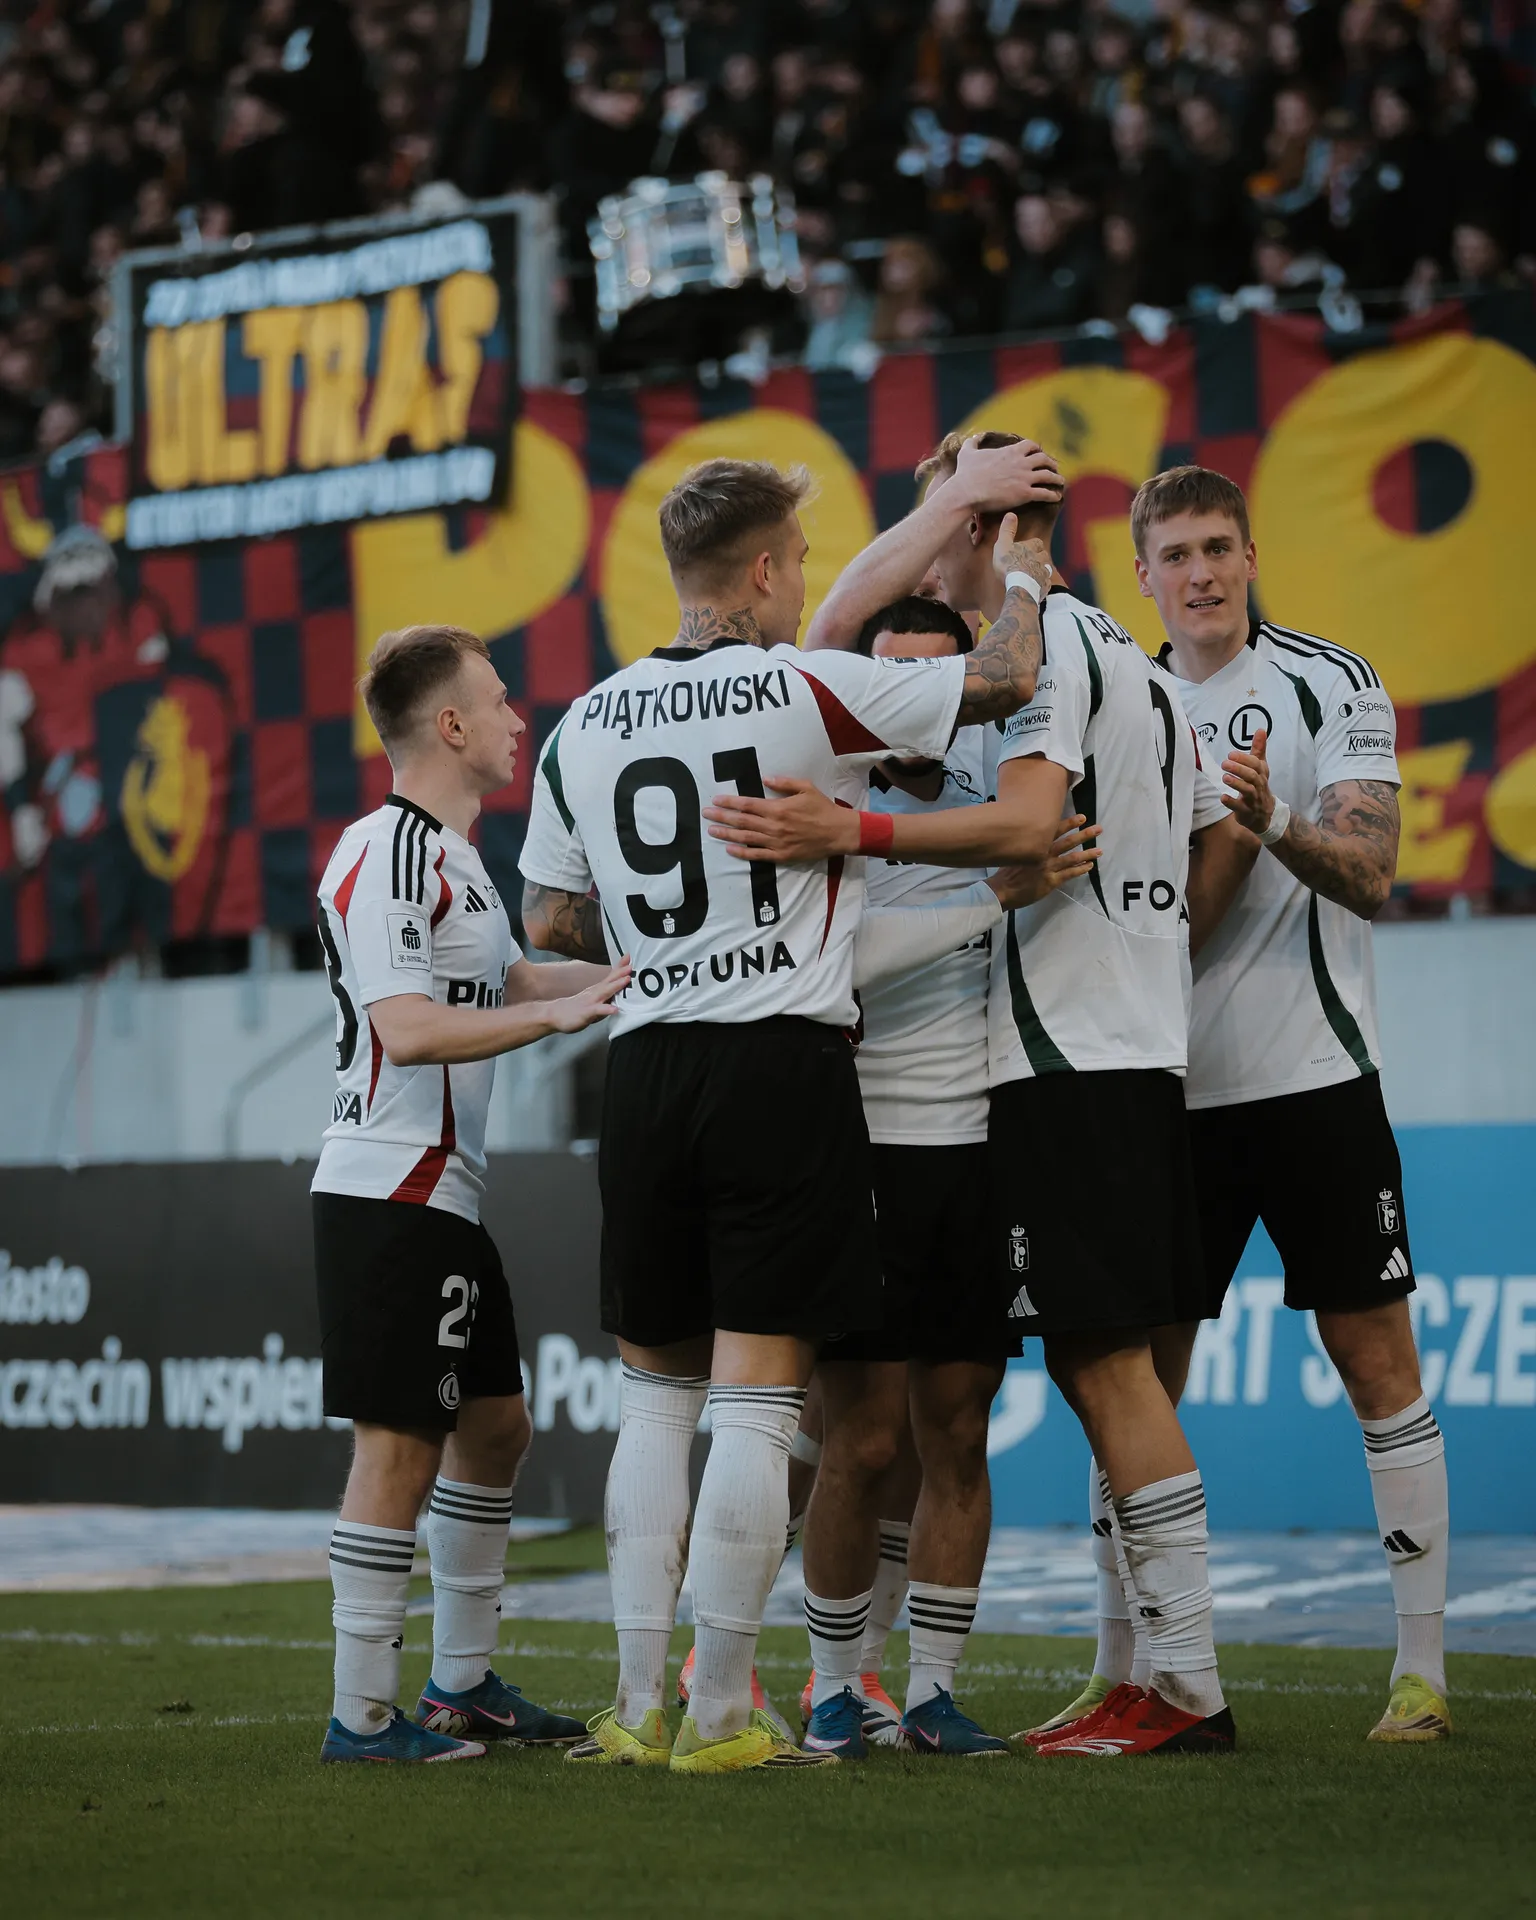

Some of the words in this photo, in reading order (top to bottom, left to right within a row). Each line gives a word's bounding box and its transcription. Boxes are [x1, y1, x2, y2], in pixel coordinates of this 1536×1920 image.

[145, 270, 500, 491] ULTRAS
[580, 668, 791, 740] PIĄTKOWSKI
[1348, 734, 1393, 752] Królewskie
[613, 745, 782, 939] 91
[0, 1335, 151, 1429] czecin
